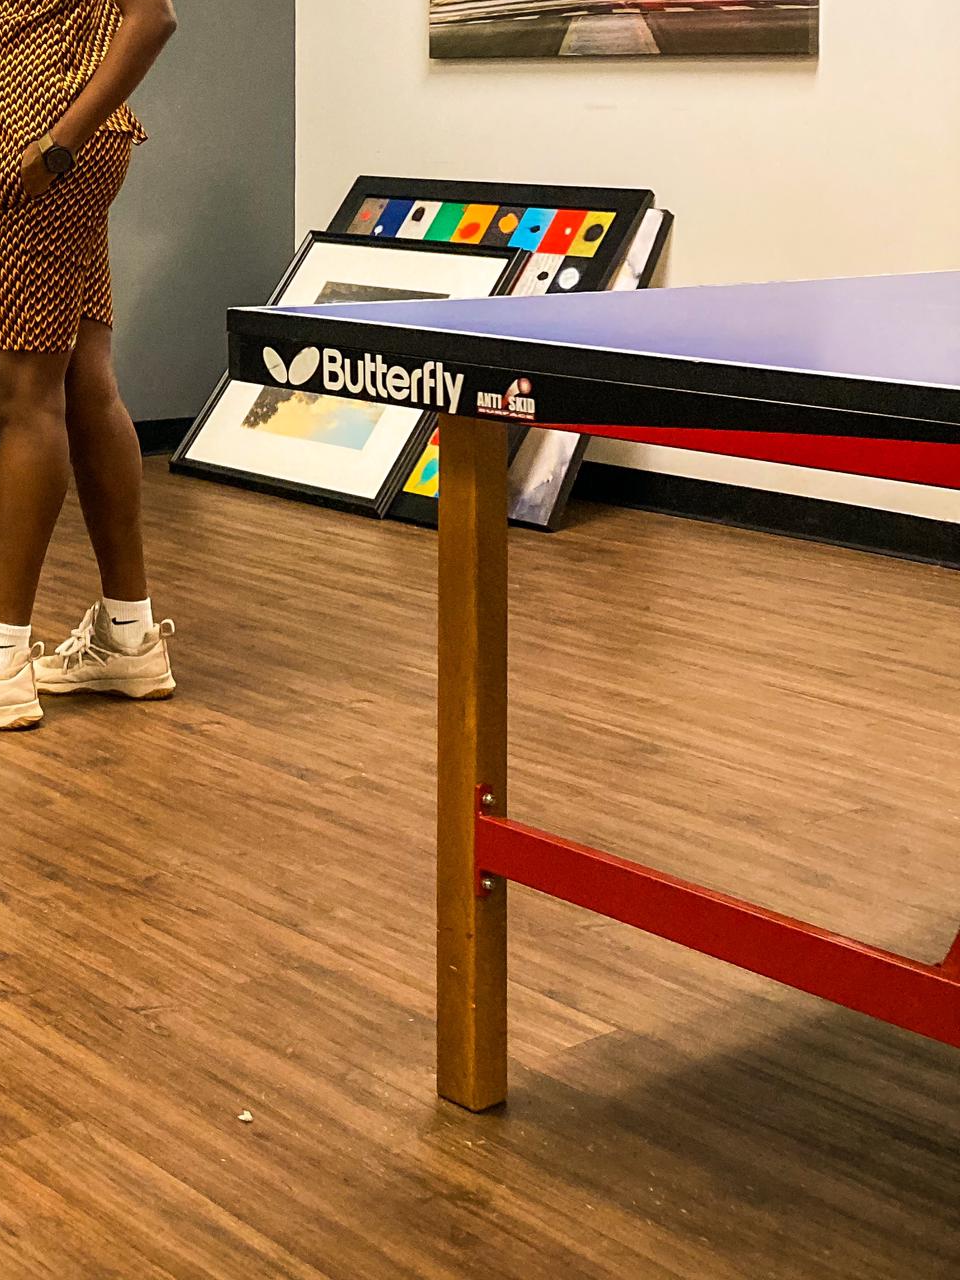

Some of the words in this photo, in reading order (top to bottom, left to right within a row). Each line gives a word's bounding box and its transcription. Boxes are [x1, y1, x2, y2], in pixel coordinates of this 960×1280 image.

[322, 347, 465, 415] Butterfly
[477, 391, 503, 410] ANTI
[508, 396, 536, 414] SKID
